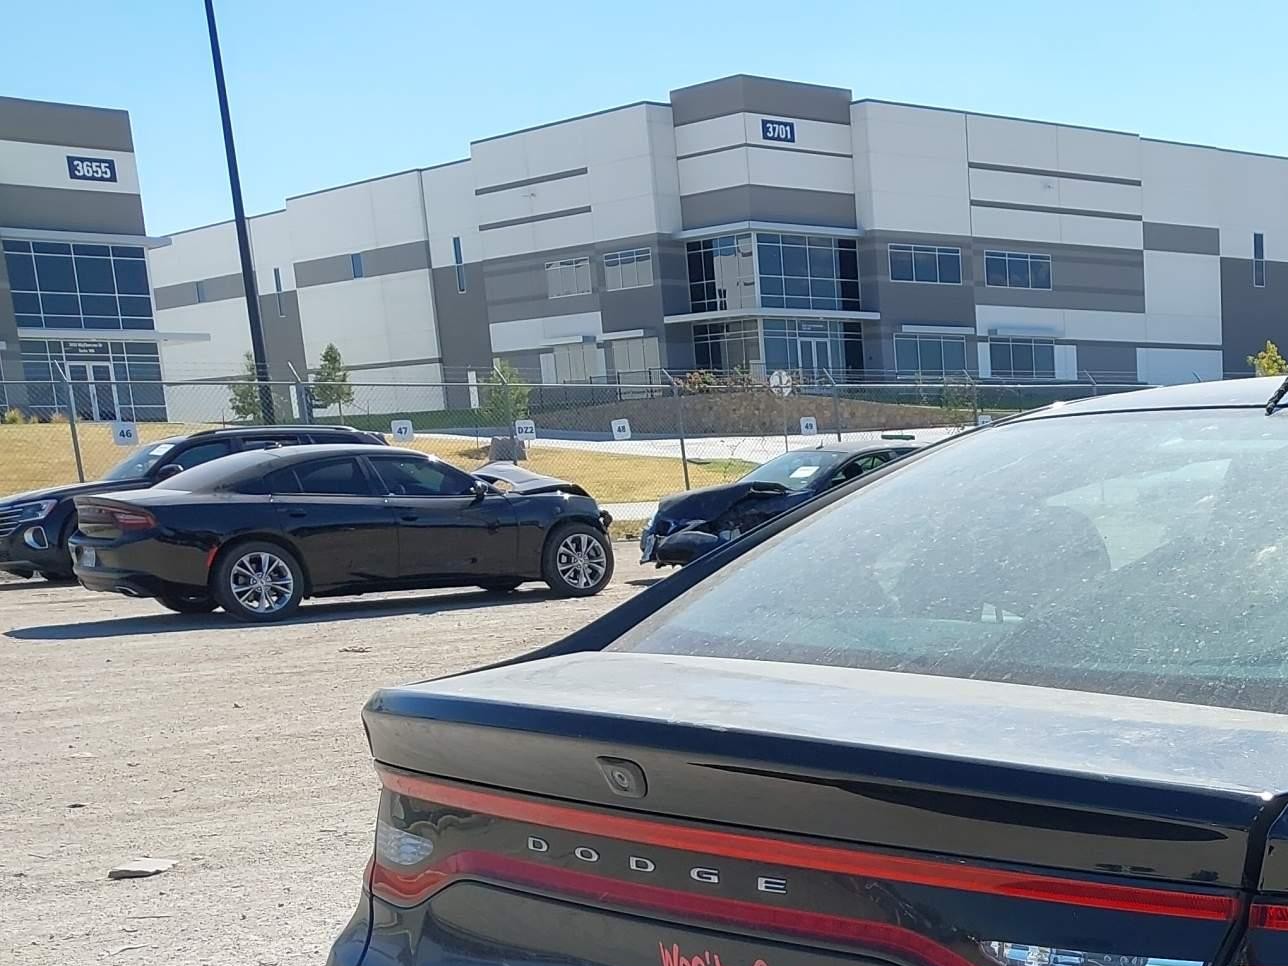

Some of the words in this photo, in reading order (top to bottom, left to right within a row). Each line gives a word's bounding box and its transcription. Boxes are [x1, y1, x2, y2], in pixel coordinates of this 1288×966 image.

[766, 123, 791, 139] 3701
[73, 160, 111, 178] 3655
[396, 426, 408, 435] 47
[517, 426, 535, 434] DZ2
[616, 425, 626, 433] 48
[804, 422, 814, 430] 49
[119, 429, 132, 438] 46
[527, 837, 787, 894] DODGE
